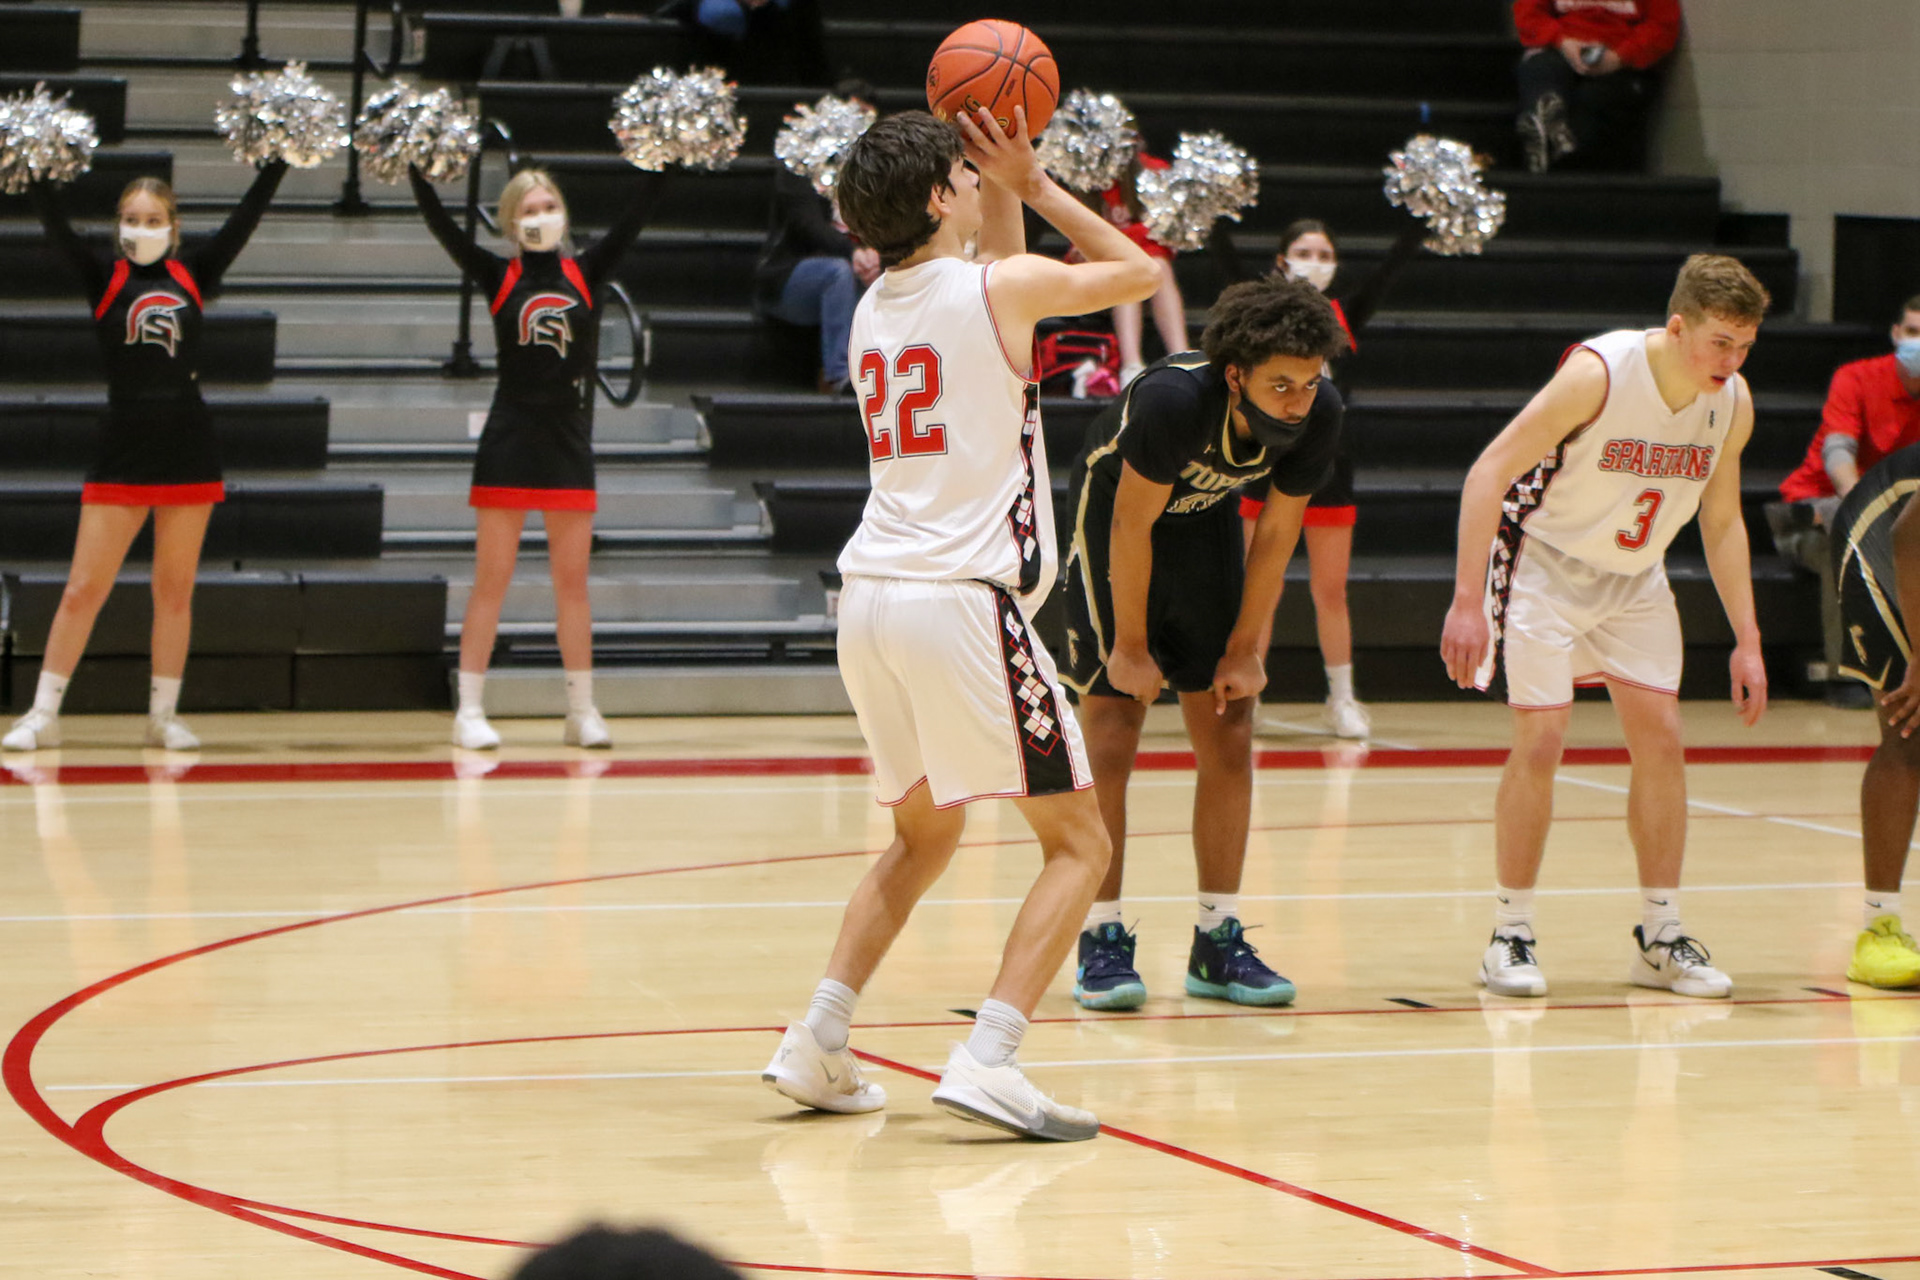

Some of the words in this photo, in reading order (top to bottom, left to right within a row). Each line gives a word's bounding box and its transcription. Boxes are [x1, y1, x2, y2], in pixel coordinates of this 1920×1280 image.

[859, 344, 948, 462] 22
[1598, 439, 1715, 481] SPARTANS
[1615, 488, 1665, 552] 3
